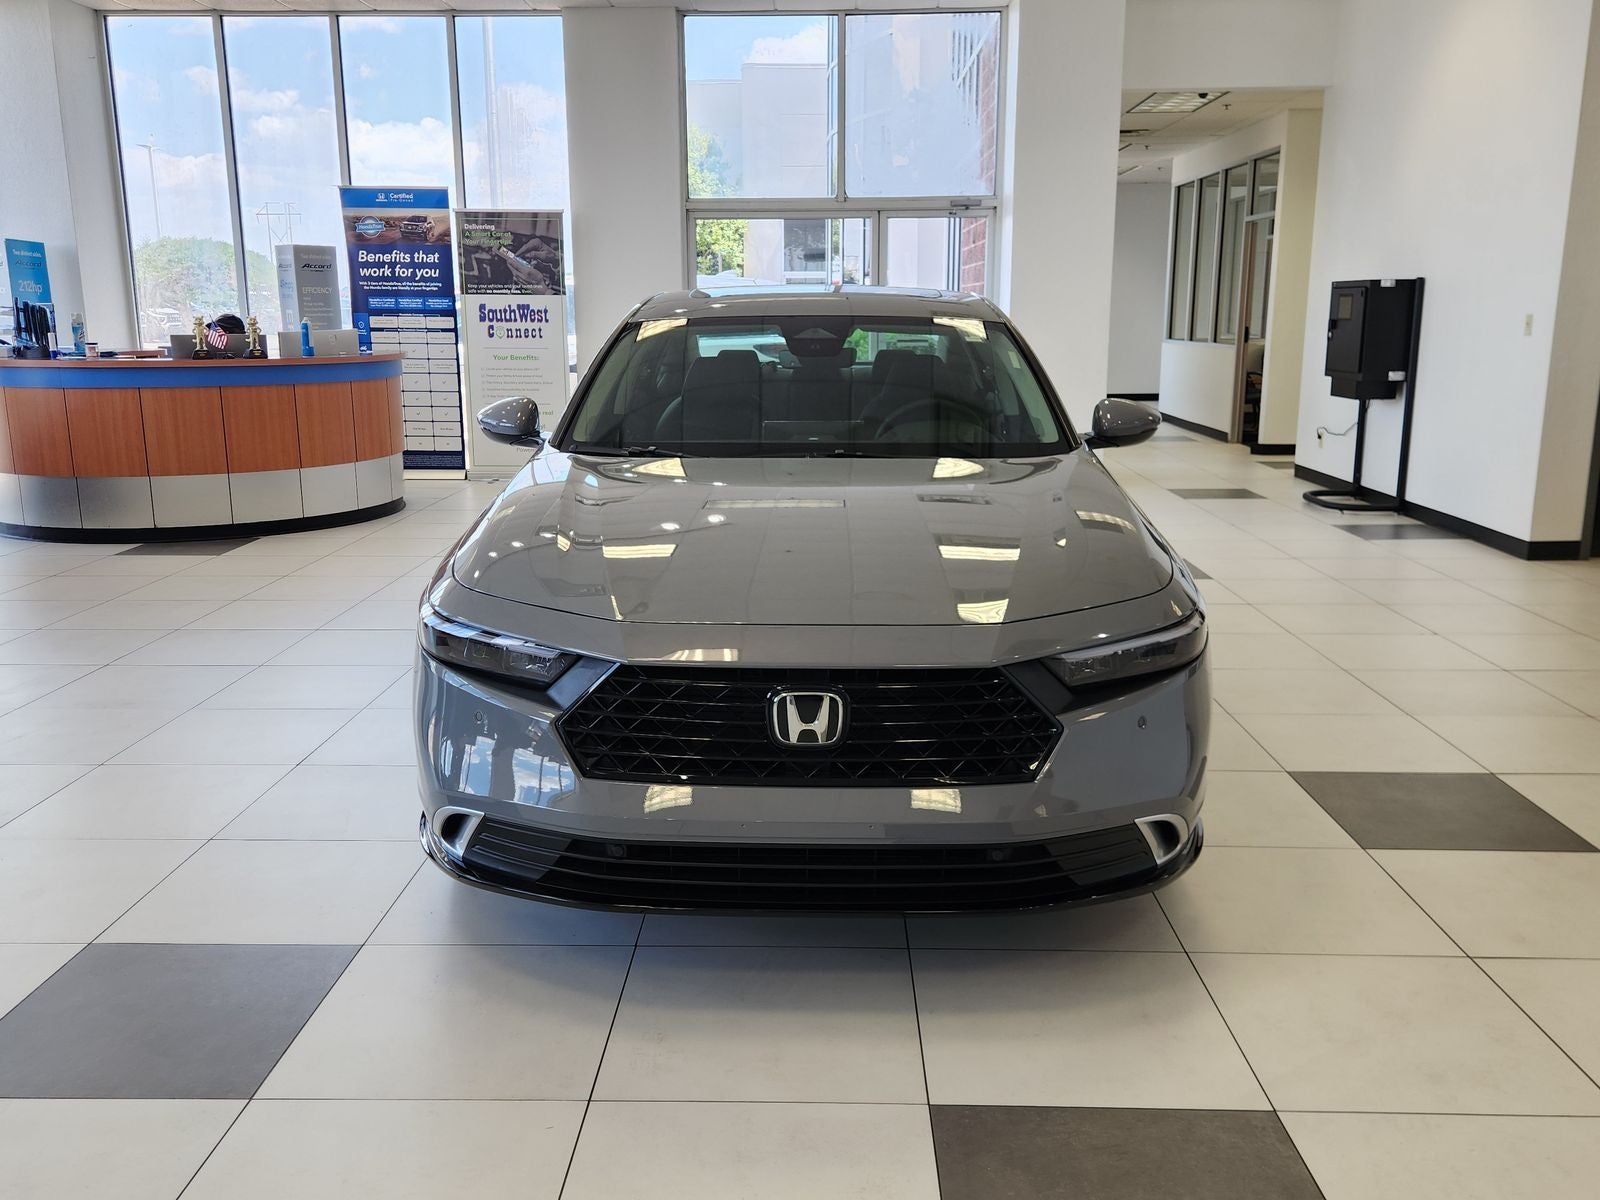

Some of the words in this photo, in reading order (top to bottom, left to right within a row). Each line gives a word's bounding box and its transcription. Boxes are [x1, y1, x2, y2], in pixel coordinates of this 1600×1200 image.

[16, 258, 42, 267] Accord
[358, 250, 410, 262] Benefits
[414, 251, 440, 263] that
[360, 265, 391, 276] work
[395, 265, 413, 276] for
[415, 268, 439, 280] you
[18, 280, 42, 294] 212hp
[479, 304, 549, 323] SouthWest
